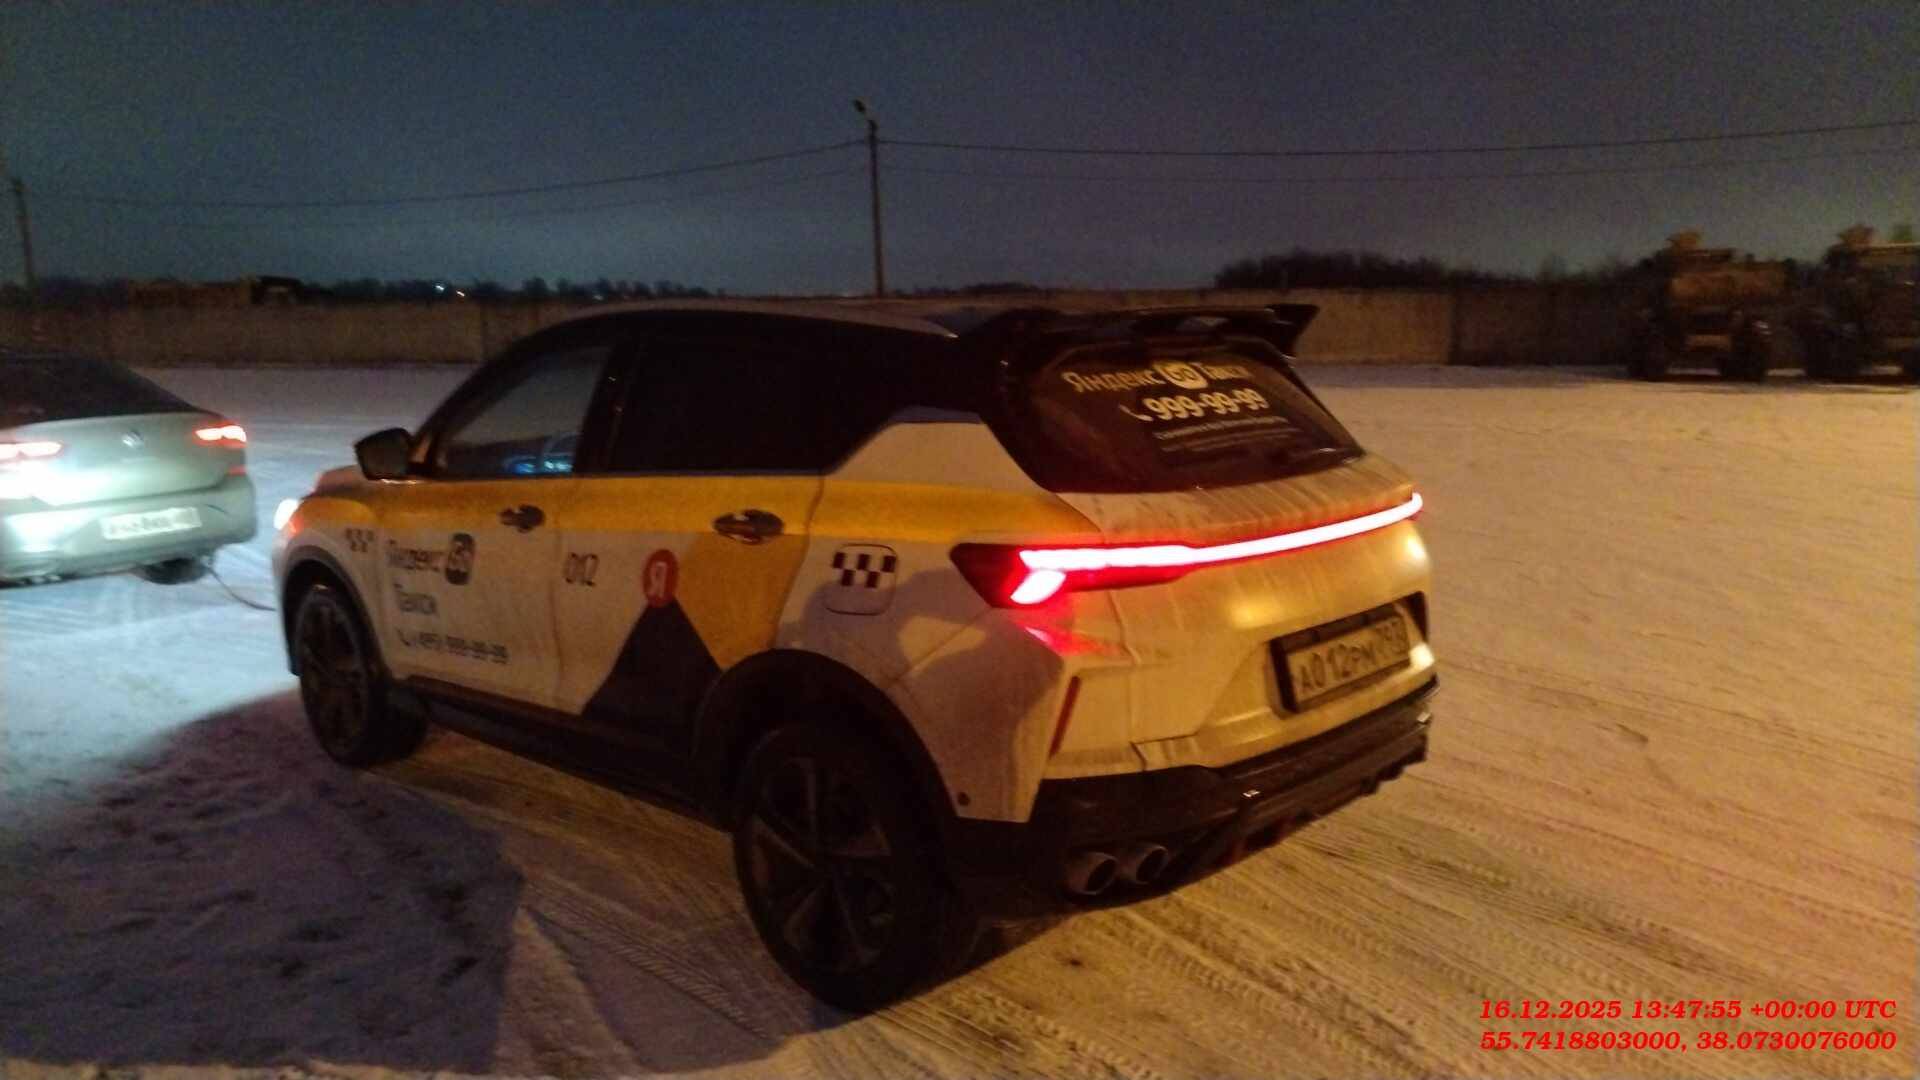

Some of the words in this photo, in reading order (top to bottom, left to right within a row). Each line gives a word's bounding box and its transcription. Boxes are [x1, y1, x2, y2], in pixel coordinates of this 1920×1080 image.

[1061, 368, 1166, 393] Яндекс
[1142, 387, 1271, 421] 999-99-99
[562, 551, 599, 587] 012
